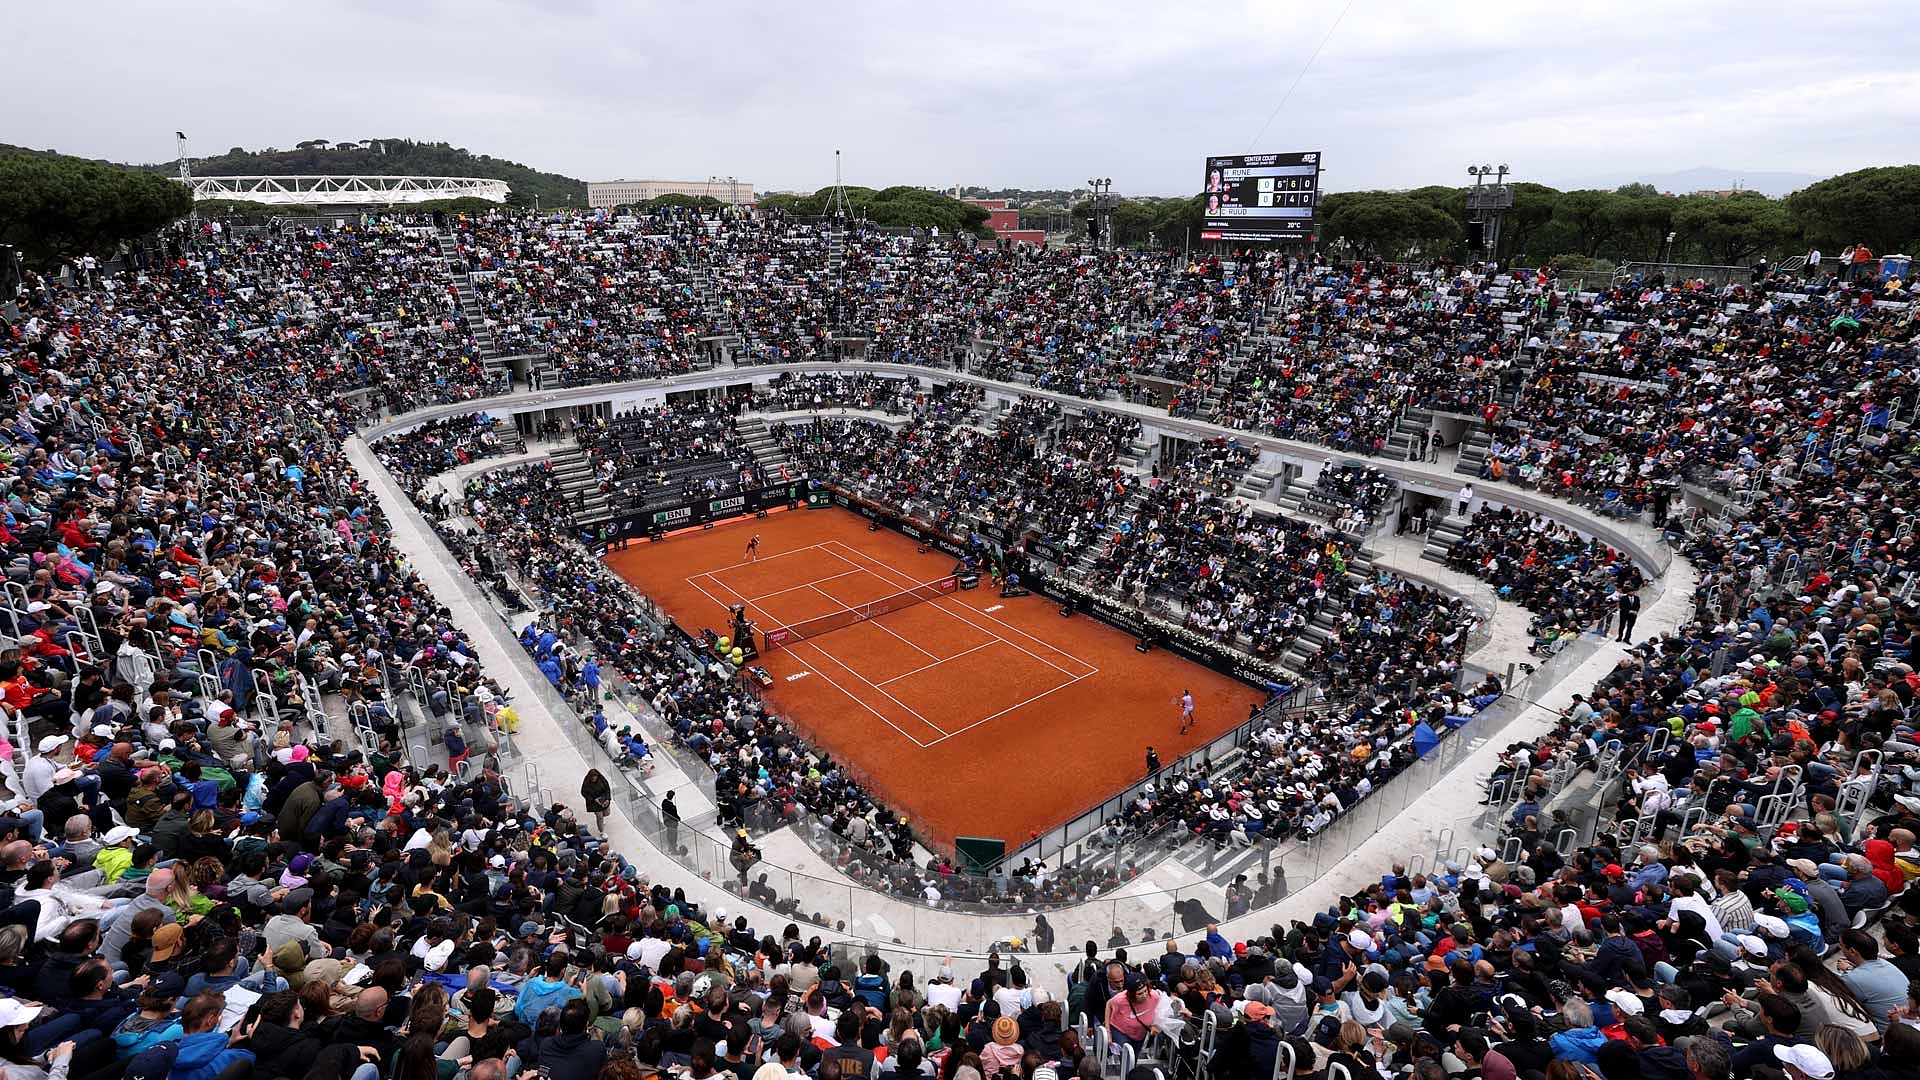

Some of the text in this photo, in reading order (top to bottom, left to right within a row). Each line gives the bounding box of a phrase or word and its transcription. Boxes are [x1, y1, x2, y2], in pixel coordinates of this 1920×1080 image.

[1232, 168, 1251, 176] RUNE
[1290, 180, 1296, 188] 6
[1276, 195, 1282, 203] 7
[1289, 195, 1295, 203] 4
[722, 497, 742, 508] BNL
[667, 509, 689, 520] BNL
[722, 506, 743, 514] PARIBAS
[668, 517, 689, 527] PARIBAS
[1175, 642, 1201, 656] DUNLOP
[785, 671, 811, 682] ROMA
